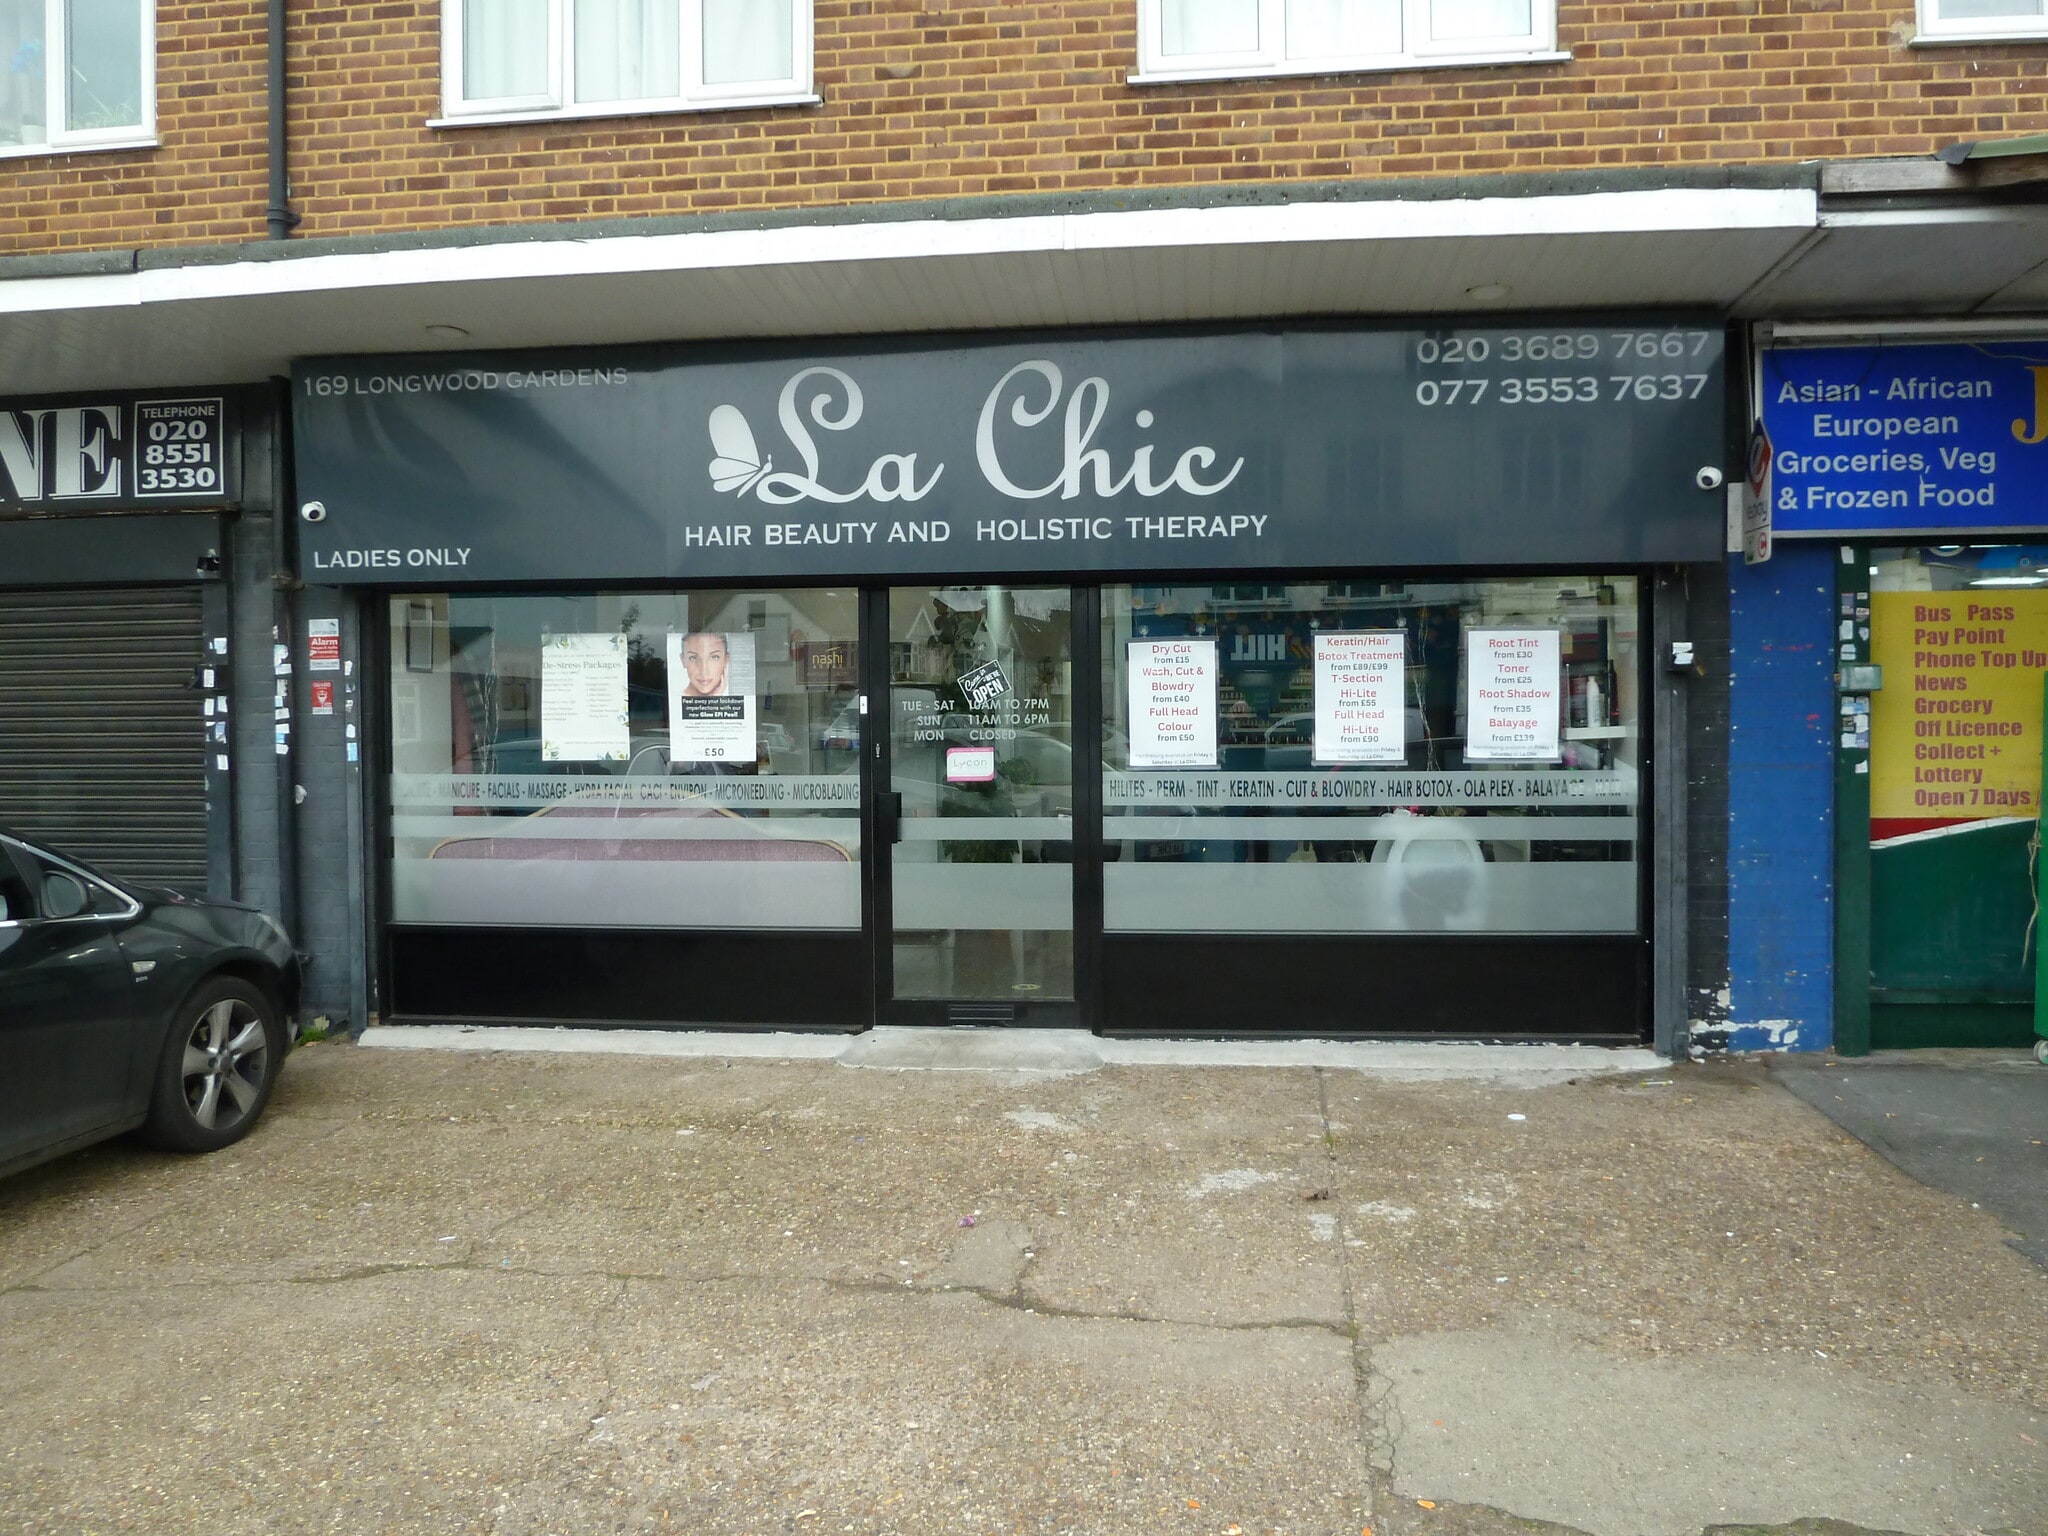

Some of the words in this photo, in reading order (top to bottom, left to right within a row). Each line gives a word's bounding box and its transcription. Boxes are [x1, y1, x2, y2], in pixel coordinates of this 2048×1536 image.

[1416, 337, 1491, 363] 020
[1500, 335, 1600, 361] 3689
[1614, 331, 1710, 358] 7667
[304, 375, 349, 397] 169
[355, 371, 499, 394] LONGWOOD
[505, 367, 628, 390] GARDENS
[1416, 379, 1488, 406] 077
[1499, 377, 1600, 404] 3553
[1610, 374, 1709, 401] 7637
[1778, 380, 1861, 404] Asian
[1886, 377, 1993, 401] African
[142, 405, 216, 419] TELEPHONE
[149, 420, 208, 441] 020
[755, 366, 944, 505] La
[974, 359, 1245, 501] Chic
[1813, 412, 1958, 442] European
[146, 443, 211, 465] 8551
[1777, 448, 1931, 476] Groceries,
[1939, 446, 1996, 475] Veg
[142, 467, 216, 489] 3530
[1778, 488, 1798, 510] &
[1807, 486, 1908, 509] Frozen
[1918, 482, 1995, 507] Food
[685, 525, 752, 547] HAIR
[765, 522, 878, 545] BEAUTY
[888, 520, 951, 543] AND
[976, 518, 1113, 541] HOLISTIC
[1126, 515, 1268, 539] THERAPY
[313, 548, 402, 568] LADIES
[408, 546, 471, 567] ONLY
[1914, 605, 1952, 622] Bus
[1967, 604, 2015, 621] Pass
[1327, 637, 1390, 646] Keratin/Hair
[1489, 639, 1514, 648] Root
[1517, 638, 1539, 647] Tint
[1914, 628, 1949, 647] Pay
[1954, 627, 2005, 645] Point
[1152, 645, 1170, 655] Dry
[1173, 644, 1191, 653] Cut
[1318, 652, 1347, 661] Botox
[1350, 651, 1403, 660] Treatment
[812, 650, 844, 665] nashi
[1154, 656, 1173, 664] from
[1914, 651, 1976, 668] Phone
[1980, 650, 2017, 668] Top
[2022, 649, 2047, 668] Up
[543, 661, 582, 669] De-Stress
[583, 661, 622, 670] Packages
[1142, 667, 1173, 677] Wash,
[1175, 667, 1194, 676] Cut
[1196, 667, 1204, 675] &
[1353, 663, 1388, 671] £89/£99
[1498, 664, 1529, 673] Toner
[1332, 674, 1383, 683] T-Section
[1494, 676, 1515, 684] from
[1914, 675, 1967, 691] News
[973, 678, 1004, 703] OPEN
[1151, 682, 1195, 692] Blowdry
[1340, 689, 1377, 698] Hi-Lite
[1479, 689, 1504, 698] Root
[1507, 689, 1550, 698] Shadow
[902, 700, 922, 711] TUE
[934, 700, 955, 710] SAT
[1005, 699, 1021, 709] TO
[1023, 698, 1050, 709] 7PM
[1152, 695, 1172, 703] from
[1339, 699, 1359, 707] from
[1149, 707, 1169, 716] Full
[1172, 707, 1198, 716] Head
[1493, 705, 1513, 713] from
[1914, 697, 1994, 716] Grocery
[917, 715, 941, 726] SUN
[968, 714, 1002, 725] 11AM
[1005, 713, 1021, 725] TO
[1024, 713, 1050, 724] 6PM
[1334, 710, 1354, 719] Full
[1357, 710, 1384, 719] Head
[1158, 722, 1193, 731] Colour
[1343, 725, 1379, 734] Hi-Lite
[1489, 718, 1538, 729] Balayage
[1914, 720, 1942, 737] Off
[1946, 719, 2022, 737] Licence
[914, 730, 944, 741] MON
[969, 729, 1016, 740] CLOSED
[1157, 734, 1177, 742] from
[704, 748, 725, 757] £50
[1914, 743, 1986, 760] Collect
[1914, 766, 1984, 784] Lottery
[487, 782, 520, 798] FACIALS
[528, 782, 567, 799] MASSAGE
[715, 783, 784, 800] MICRONEEDLING
[792, 783, 859, 801] MICROBLADING
[1109, 780, 1145, 798] HILITES
[1156, 780, 1186, 798] PERM
[1197, 780, 1219, 798] TINT
[1230, 780, 1275, 798] KERATIN
[1286, 780, 1308, 798] CUT
[1310, 781, 1318, 798] &
[1322, 780, 1377, 798] BLOWDRY
[1387, 780, 1413, 797] HAIR
[1416, 780, 1453, 797] BOTOX
[1464, 780, 1487, 797] OLA
[1490, 779, 1515, 797] PLEX
[1914, 789, 1965, 808] Open
[1969, 789, 1979, 805] 7
[1983, 788, 2031, 807] Days
